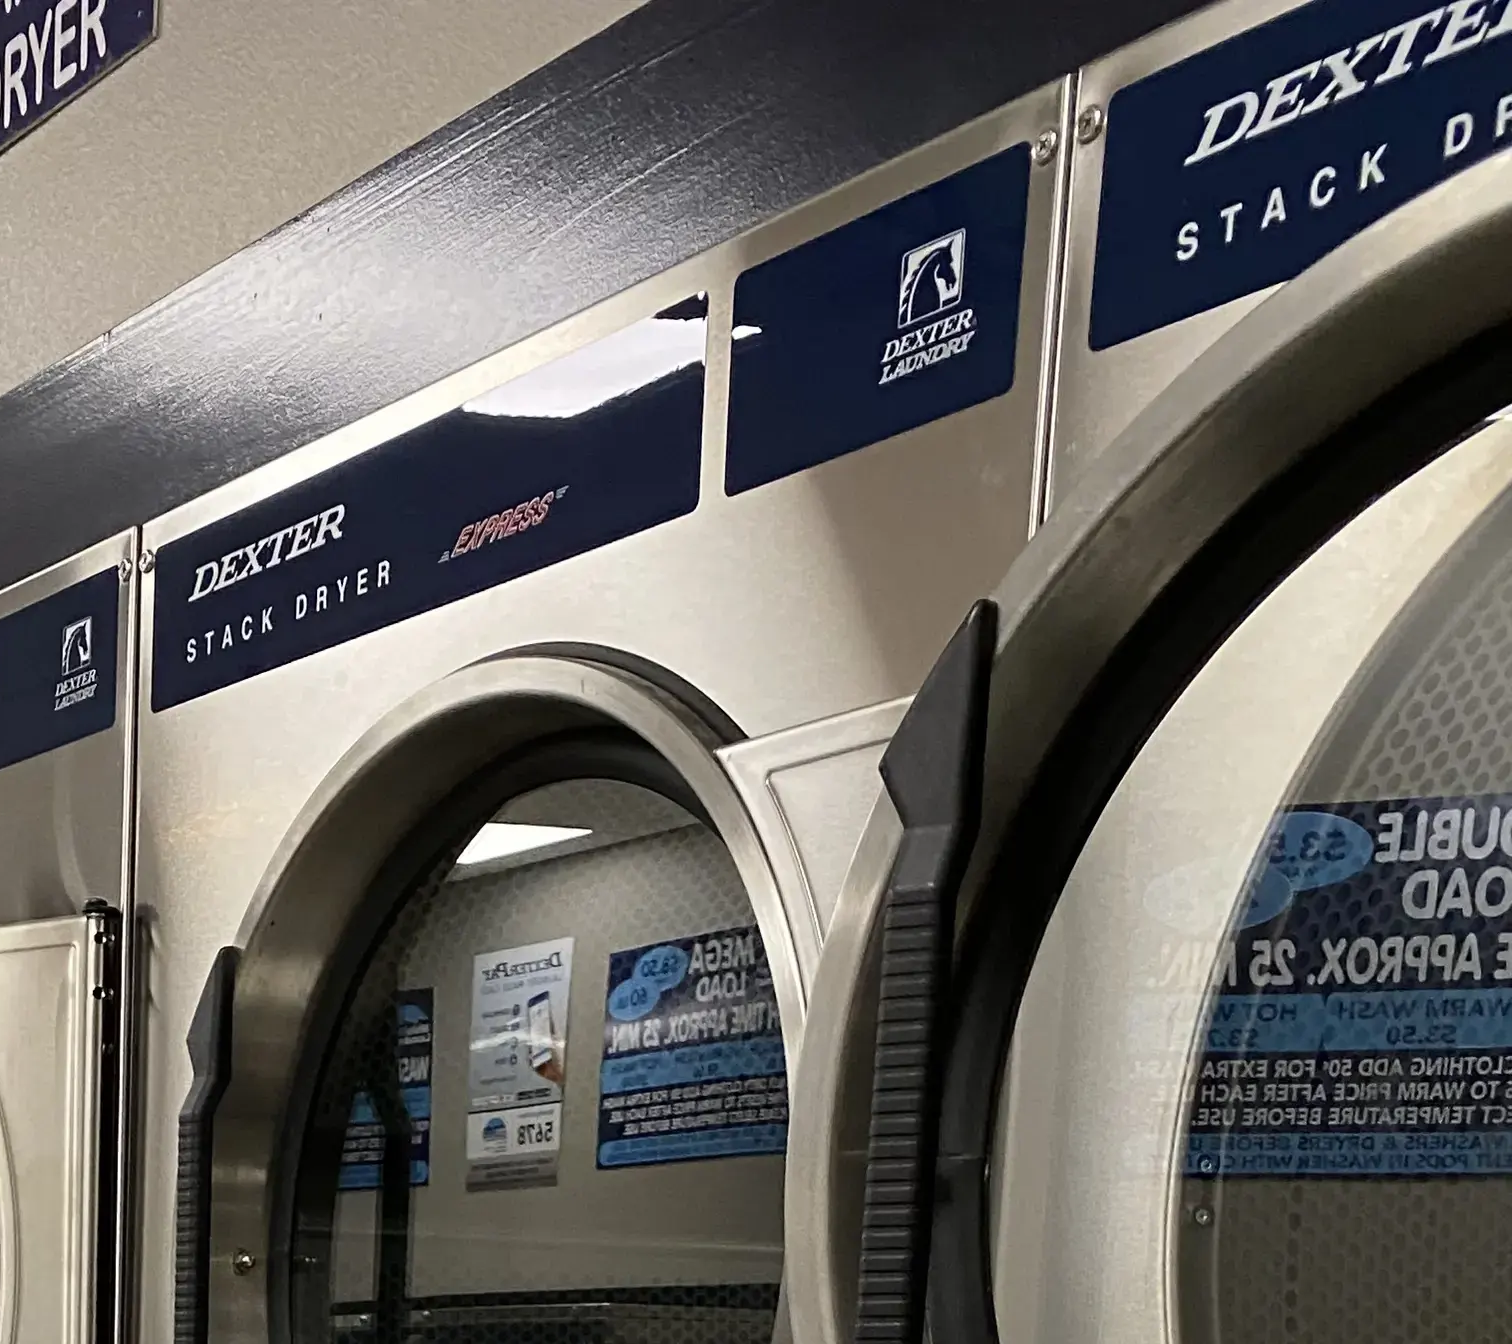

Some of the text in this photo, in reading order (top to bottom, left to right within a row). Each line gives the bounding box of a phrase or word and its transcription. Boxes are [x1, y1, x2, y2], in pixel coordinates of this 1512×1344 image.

[1176, 143, 1388, 262] STACK
[878, 330, 976, 385] LAUNDRY
[880, 308, 974, 364] DEXTER
[188, 491, 555, 603] DEXTER EXPRESS
[186, 559, 392, 664] STACK DRYER
[55, 669, 97, 697] DEXTER
